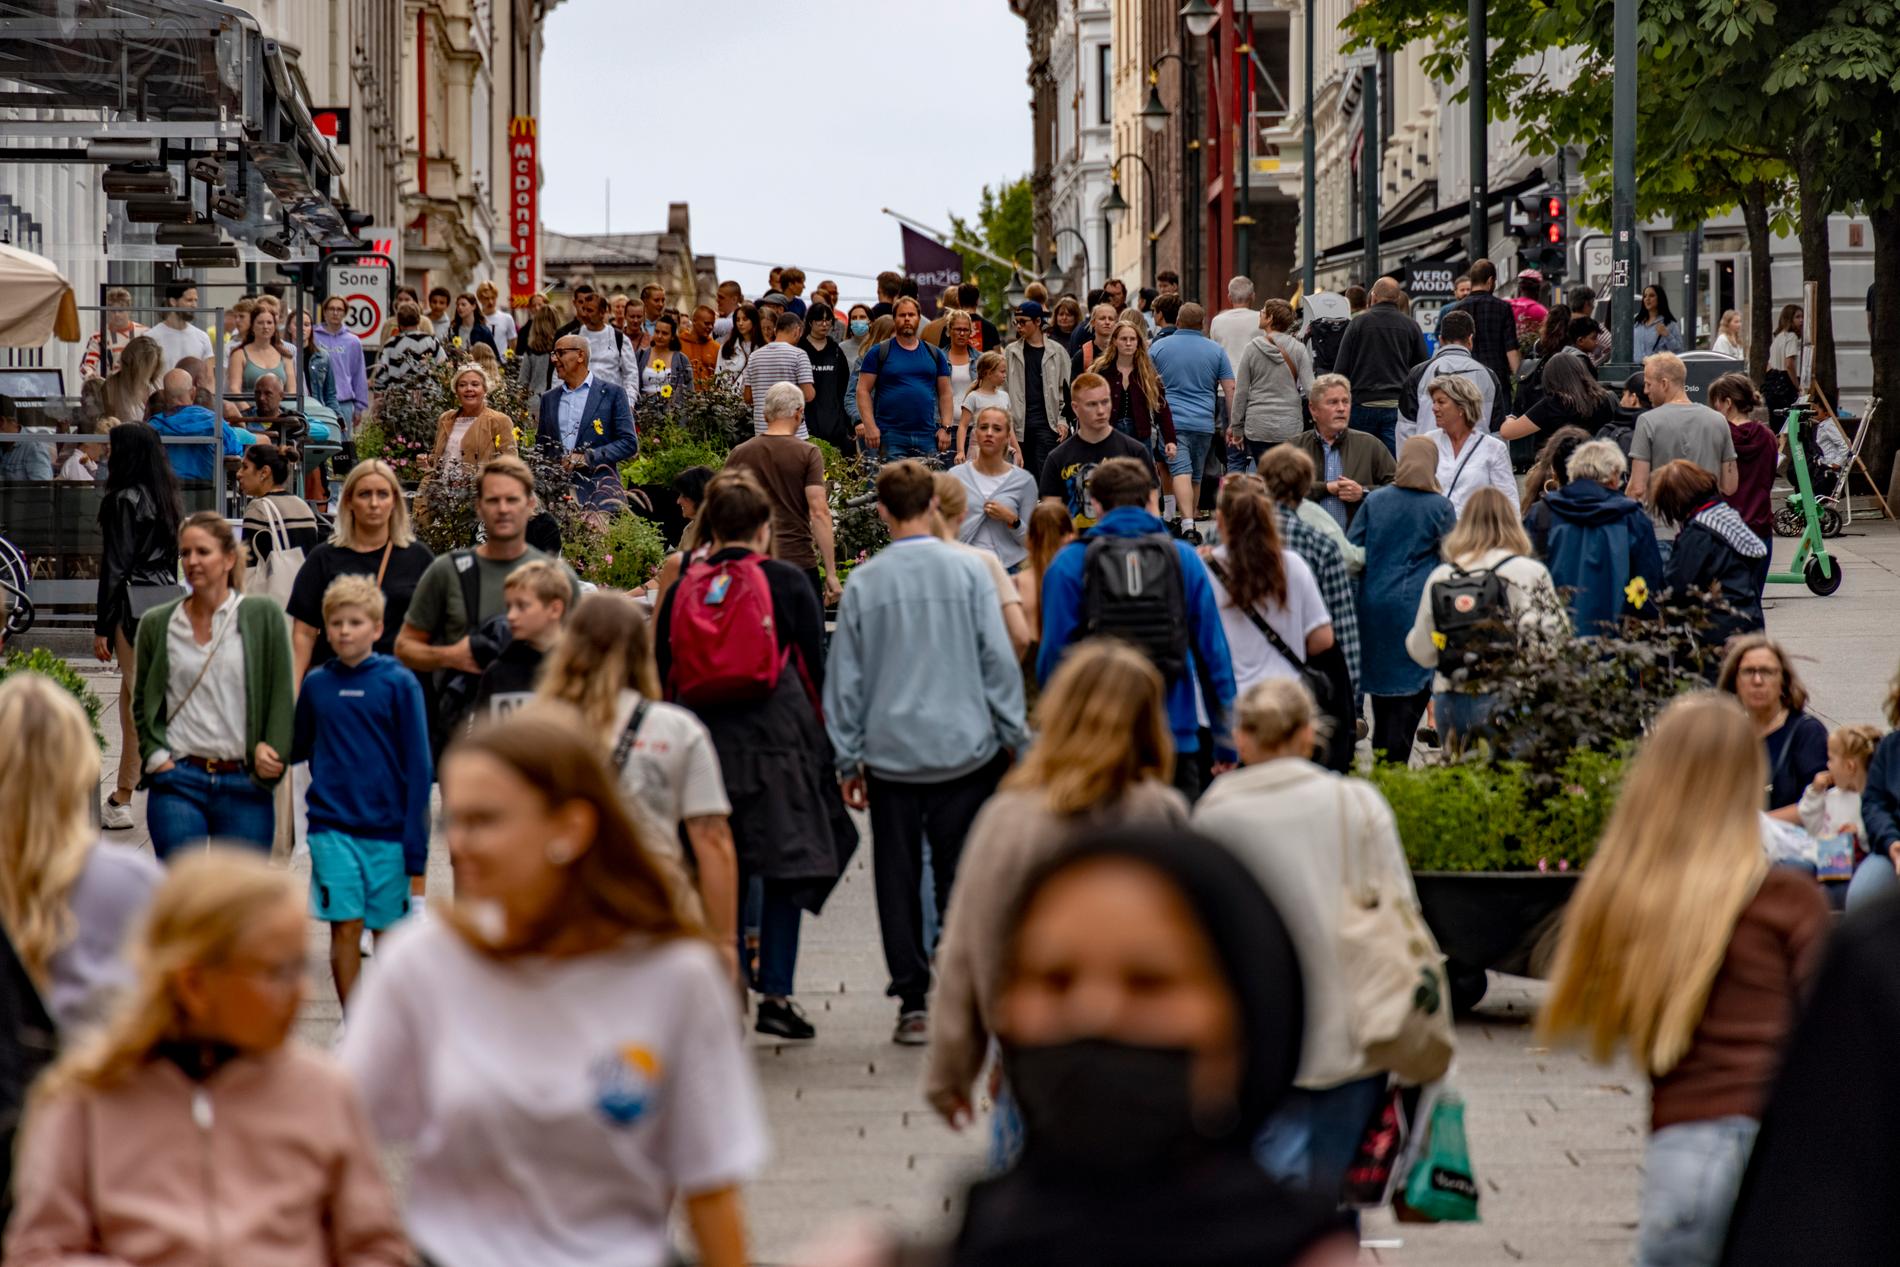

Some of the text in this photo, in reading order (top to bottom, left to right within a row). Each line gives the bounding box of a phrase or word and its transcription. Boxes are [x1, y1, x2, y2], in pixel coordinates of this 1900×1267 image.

[514, 143, 532, 285] McDonald's
[339, 271, 379, 286] Sone
[909, 268, 961, 286] enzie
[1412, 270, 1453, 282] VERO
[1411, 281, 1455, 291] MODA
[345, 306, 373, 327] 30
